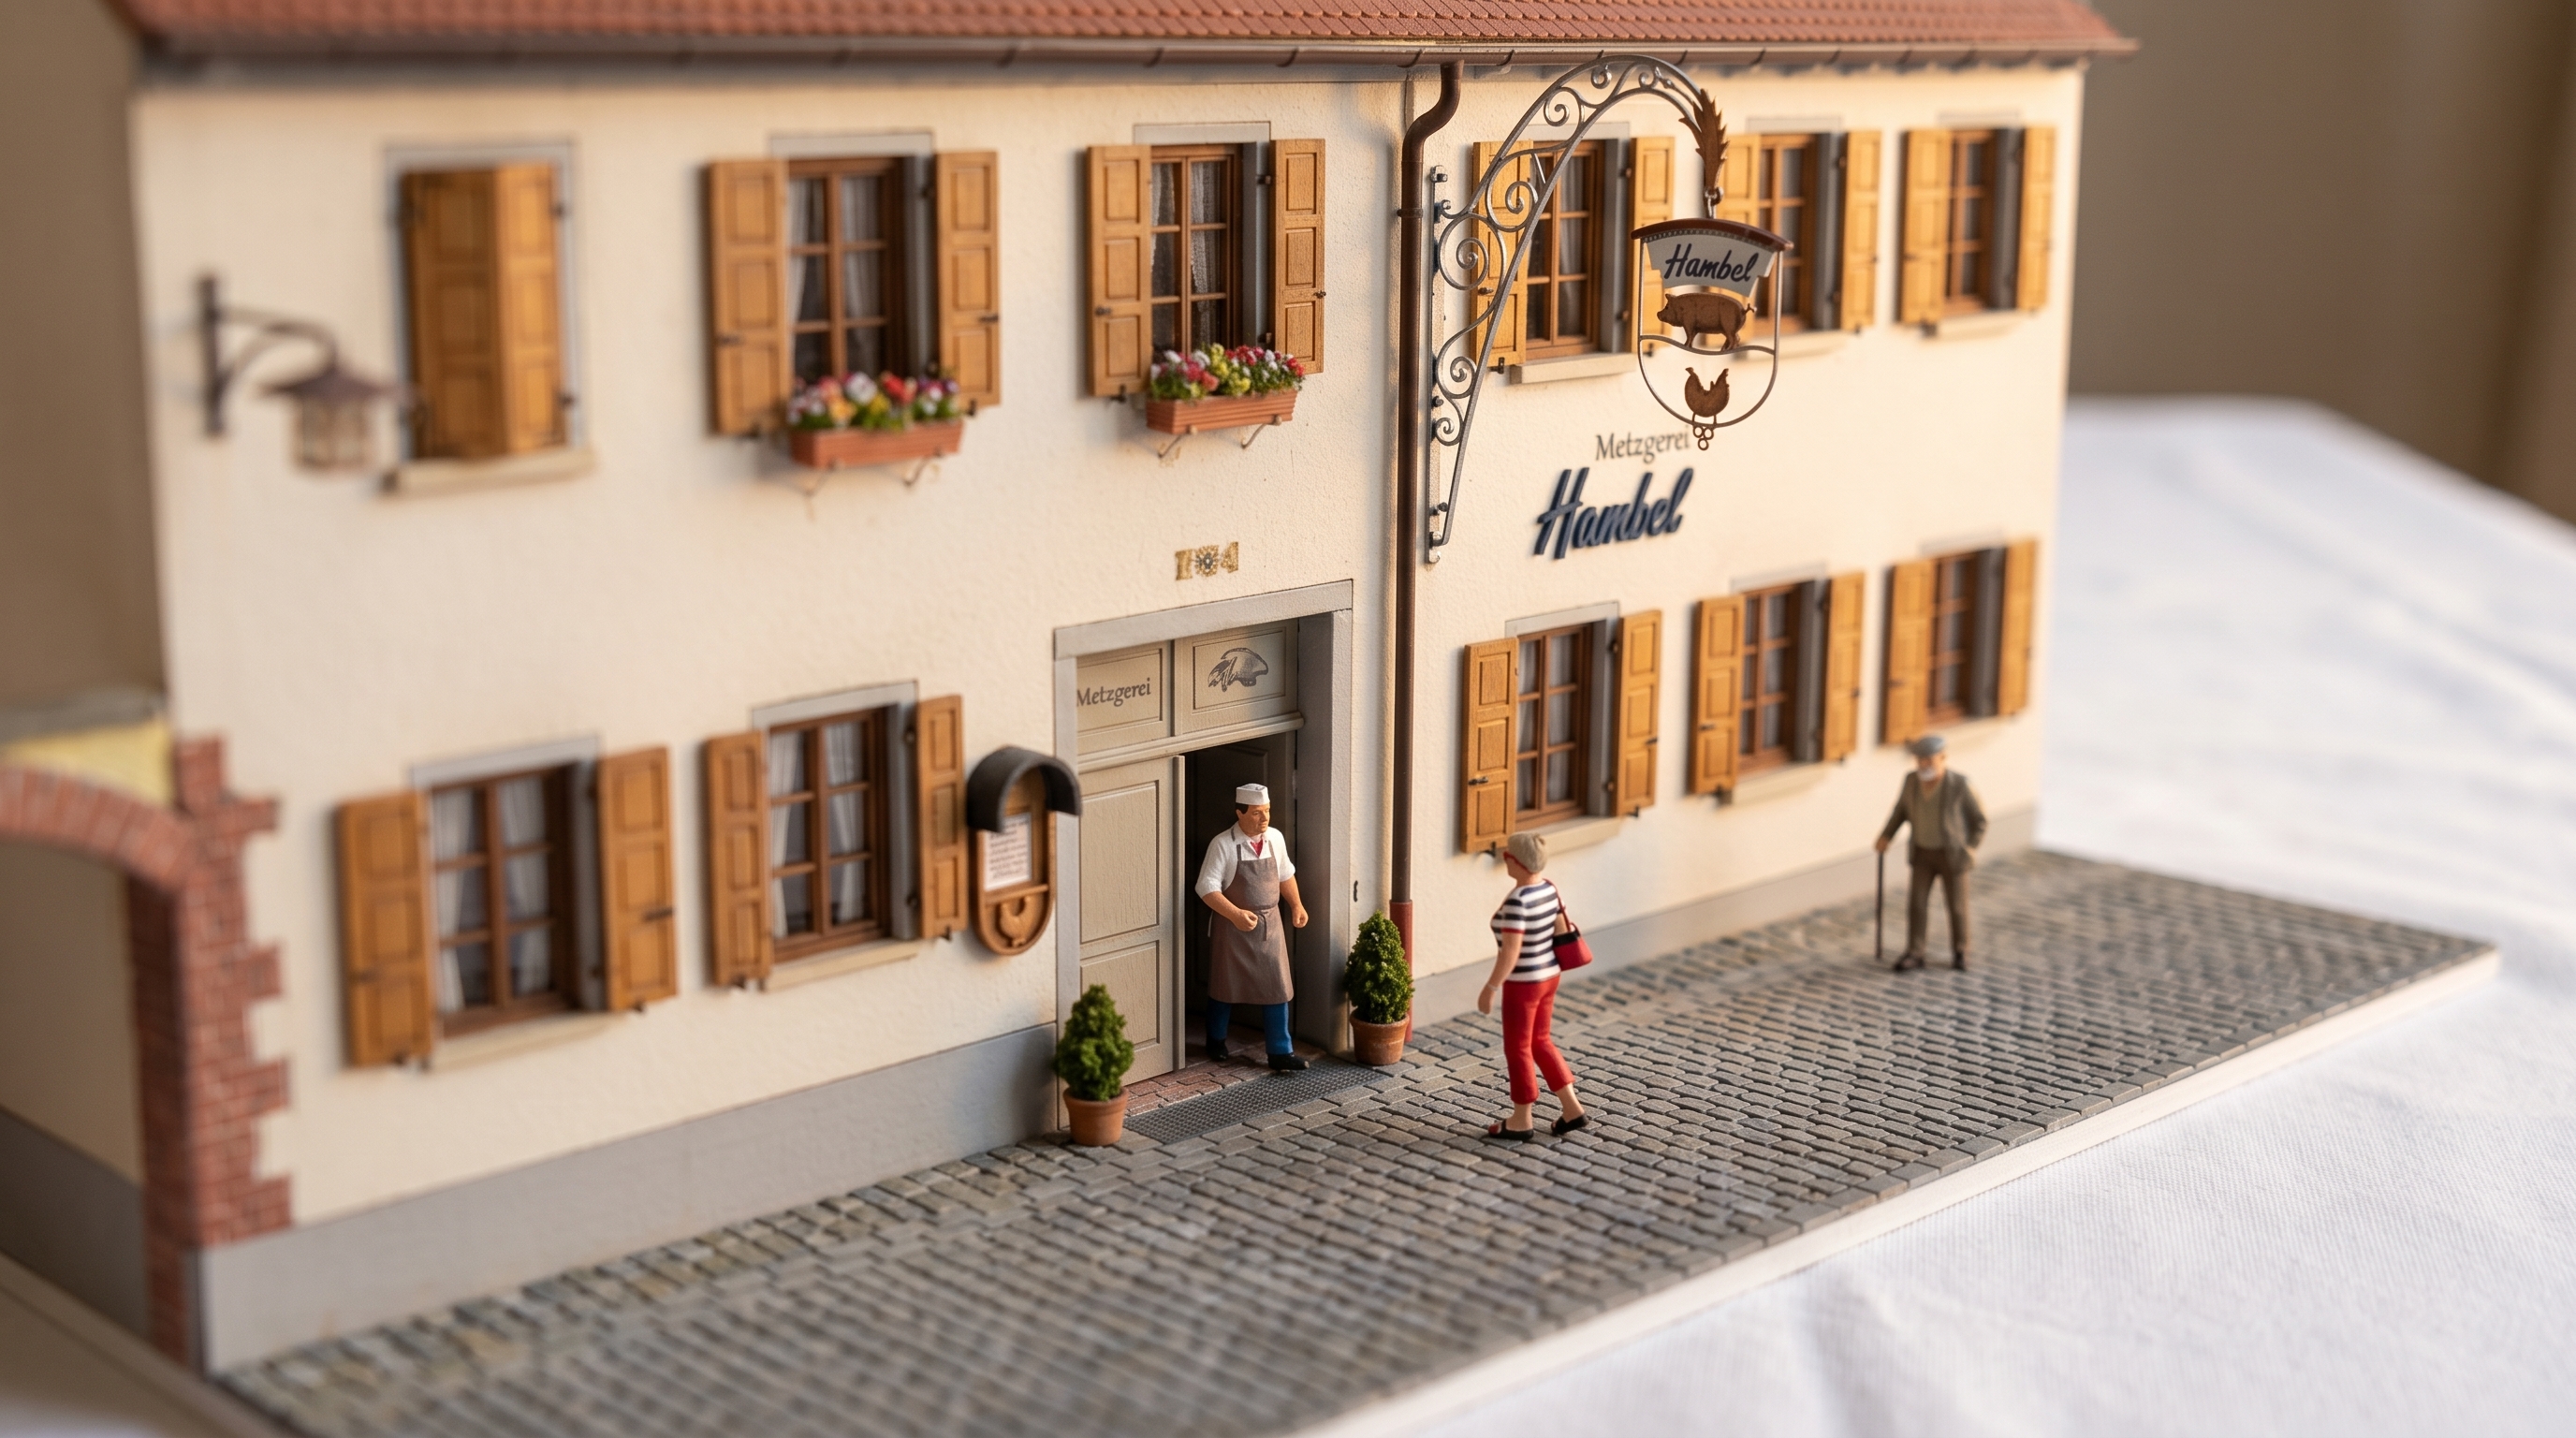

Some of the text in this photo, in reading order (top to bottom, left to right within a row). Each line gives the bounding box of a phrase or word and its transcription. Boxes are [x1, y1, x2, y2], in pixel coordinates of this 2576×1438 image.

[1663, 243, 1759, 283] Hambel
[1595, 423, 1690, 464] Metzgerei
[1533, 466, 1694, 560] Hambel
[1076, 677, 1151, 708] Metzgerei
